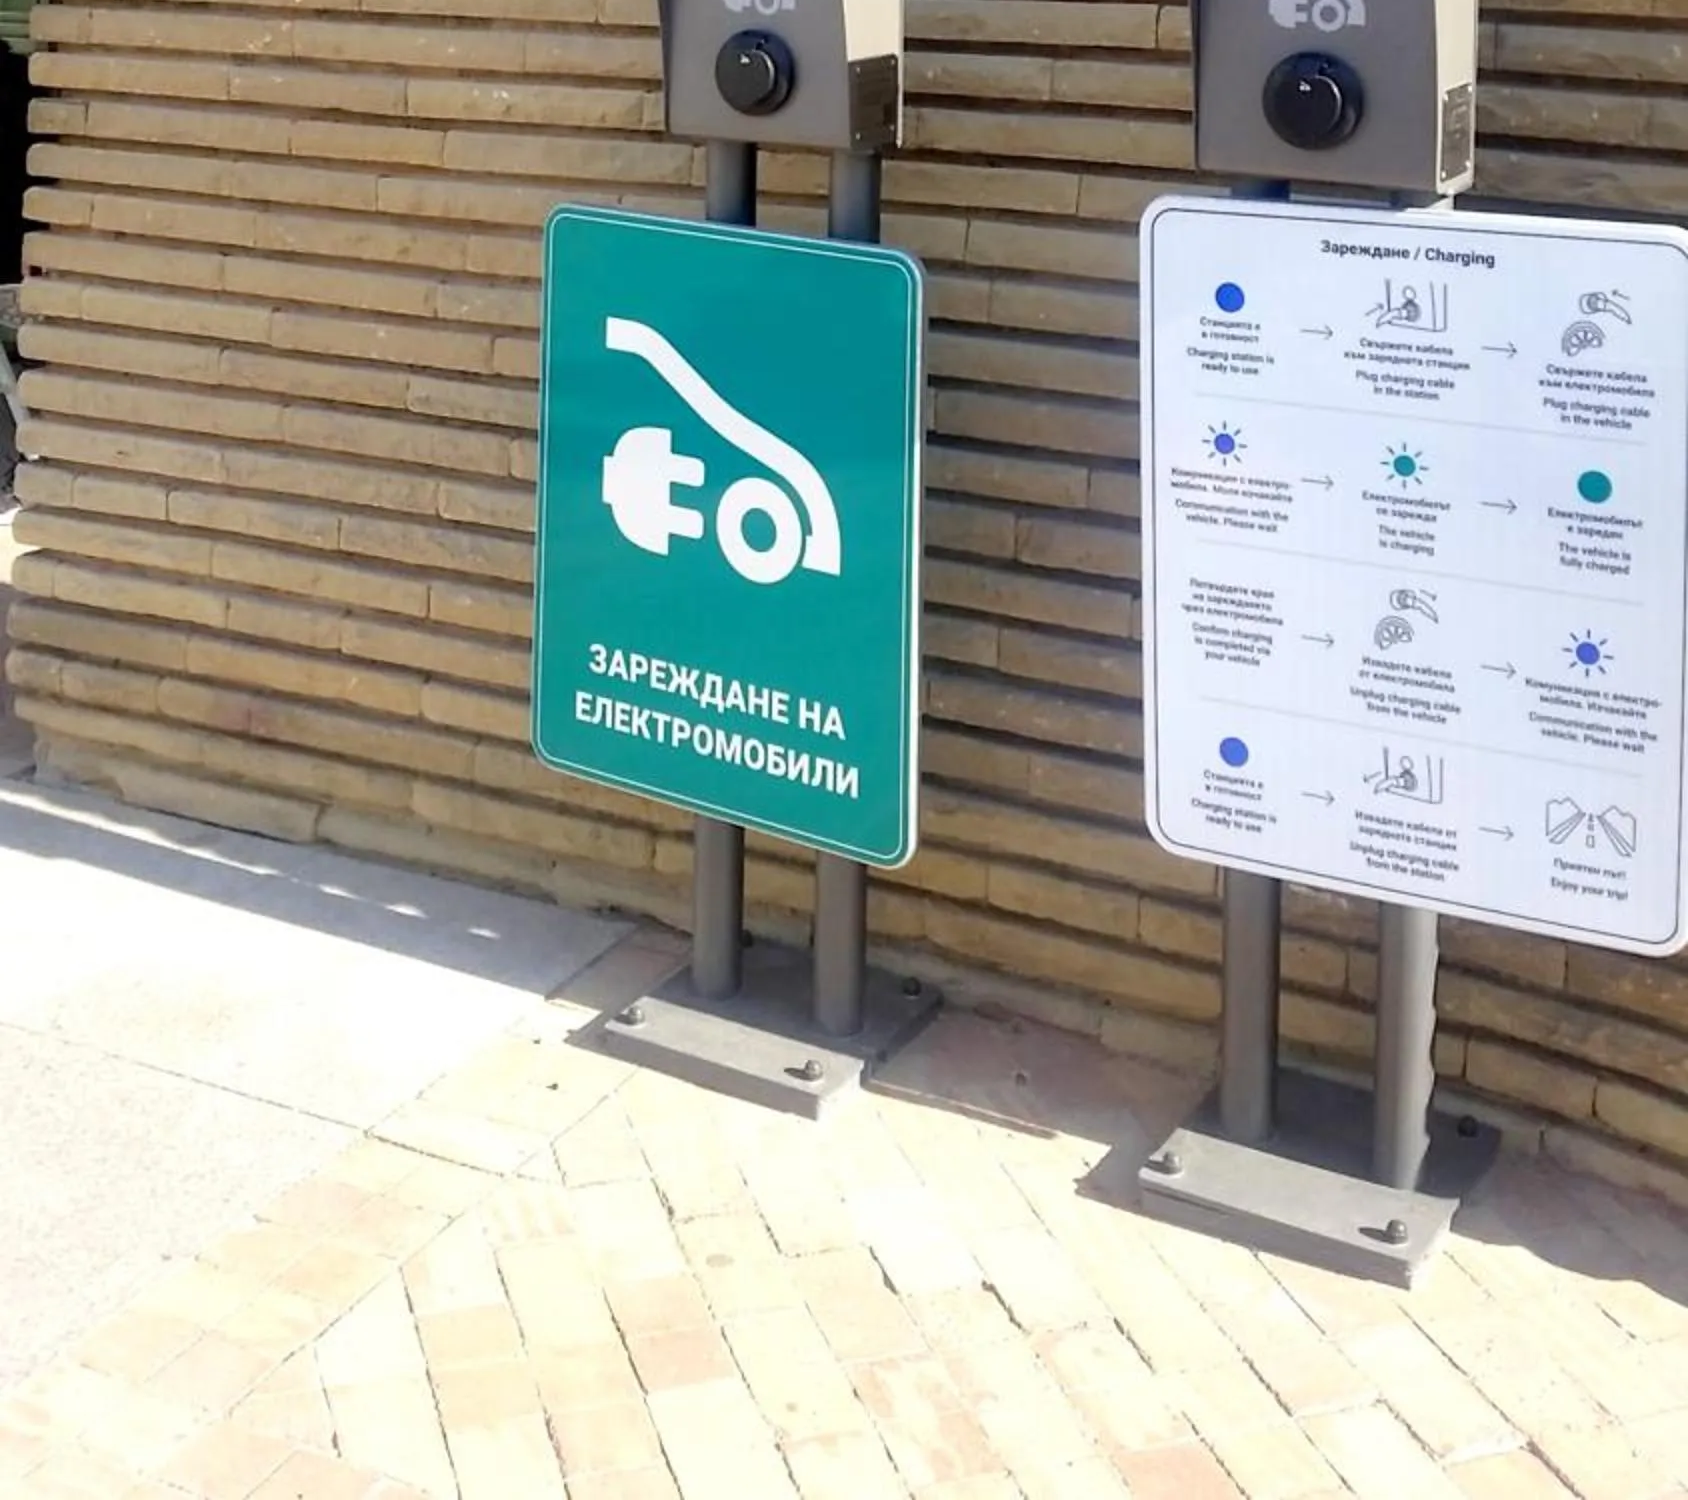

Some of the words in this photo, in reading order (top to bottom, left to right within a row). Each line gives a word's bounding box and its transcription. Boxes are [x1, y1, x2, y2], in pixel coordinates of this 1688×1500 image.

[1321, 240, 1410, 260] Зареждане
[1414, 241, 1421, 261] /
[1425, 248, 1495, 268] Charging
[1187, 347, 1228, 361] Charging
[1232, 352, 1263, 362] station
[1201, 362, 1227, 374] ready
[1230, 365, 1239, 373] to
[1356, 370, 1378, 384] Plug
[1381, 373, 1424, 388] charging
[1427, 376, 1455, 389] cable
[1386, 387, 1401, 397] the
[1543, 397, 1567, 411] Plug
[1570, 400, 1617, 417] charging
[1620, 407, 1650, 418] cable
[1561, 413, 1571, 422] in
[1574, 414, 1590, 425] the
[1594, 417, 1632, 429] vehicle
[1175, 498, 1248, 517] Communication
[1251, 507, 1270, 520] with
[1274, 510, 1289, 522] the
[1224, 517, 1255, 531] Please
[1379, 525, 1396, 537] The
[1400, 527, 1435, 541] vehicle
[1391, 540, 1434, 556] charging
[1559, 542, 1578, 554] The
[1582, 547, 1619, 560] vehicle
[1622, 551, 1631, 561] is
[1560, 556, 1583, 570] fully
[1586, 560, 1629, 575] charged
[1192, 622, 1229, 635] Confirm
[1232, 629, 1273, 645] charging
[1205, 637, 1255, 655] completed
[1205, 650, 1225, 663] your
[1228, 653, 1260, 667] vehicle
[589, 643, 791, 724] ЗАРЕЖДАНЕ
[799, 697, 846, 741] НА
[1350, 686, 1385, 703] Unplug
[1388, 692, 1430, 711] charging
[1434, 701, 1461, 714] cable
[1393, 706, 1409, 718] the
[1412, 709, 1447, 724] vehicle
[1529, 712, 1612, 734] Communication
[1616, 724, 1638, 738] with
[1640, 731, 1657, 742] the
[575, 691, 859, 799] ЕЛЕКТРОМОБИЛИ
[1583, 734, 1619, 749] Please
[1191, 798, 1232, 816] Charging
[1234, 806, 1266, 821] station
[1205, 814, 1231, 829] ready
[1350, 841, 1384, 860] Unplug
[1387, 849, 1430, 869] charging
[1433, 859, 1460, 872] cable
[1367, 858, 1389, 871] from
[1393, 863, 1408, 875] the
[1411, 867, 1445, 881] station
[1551, 877, 1578, 893] Enjoy
[1582, 886, 1604, 896] your
